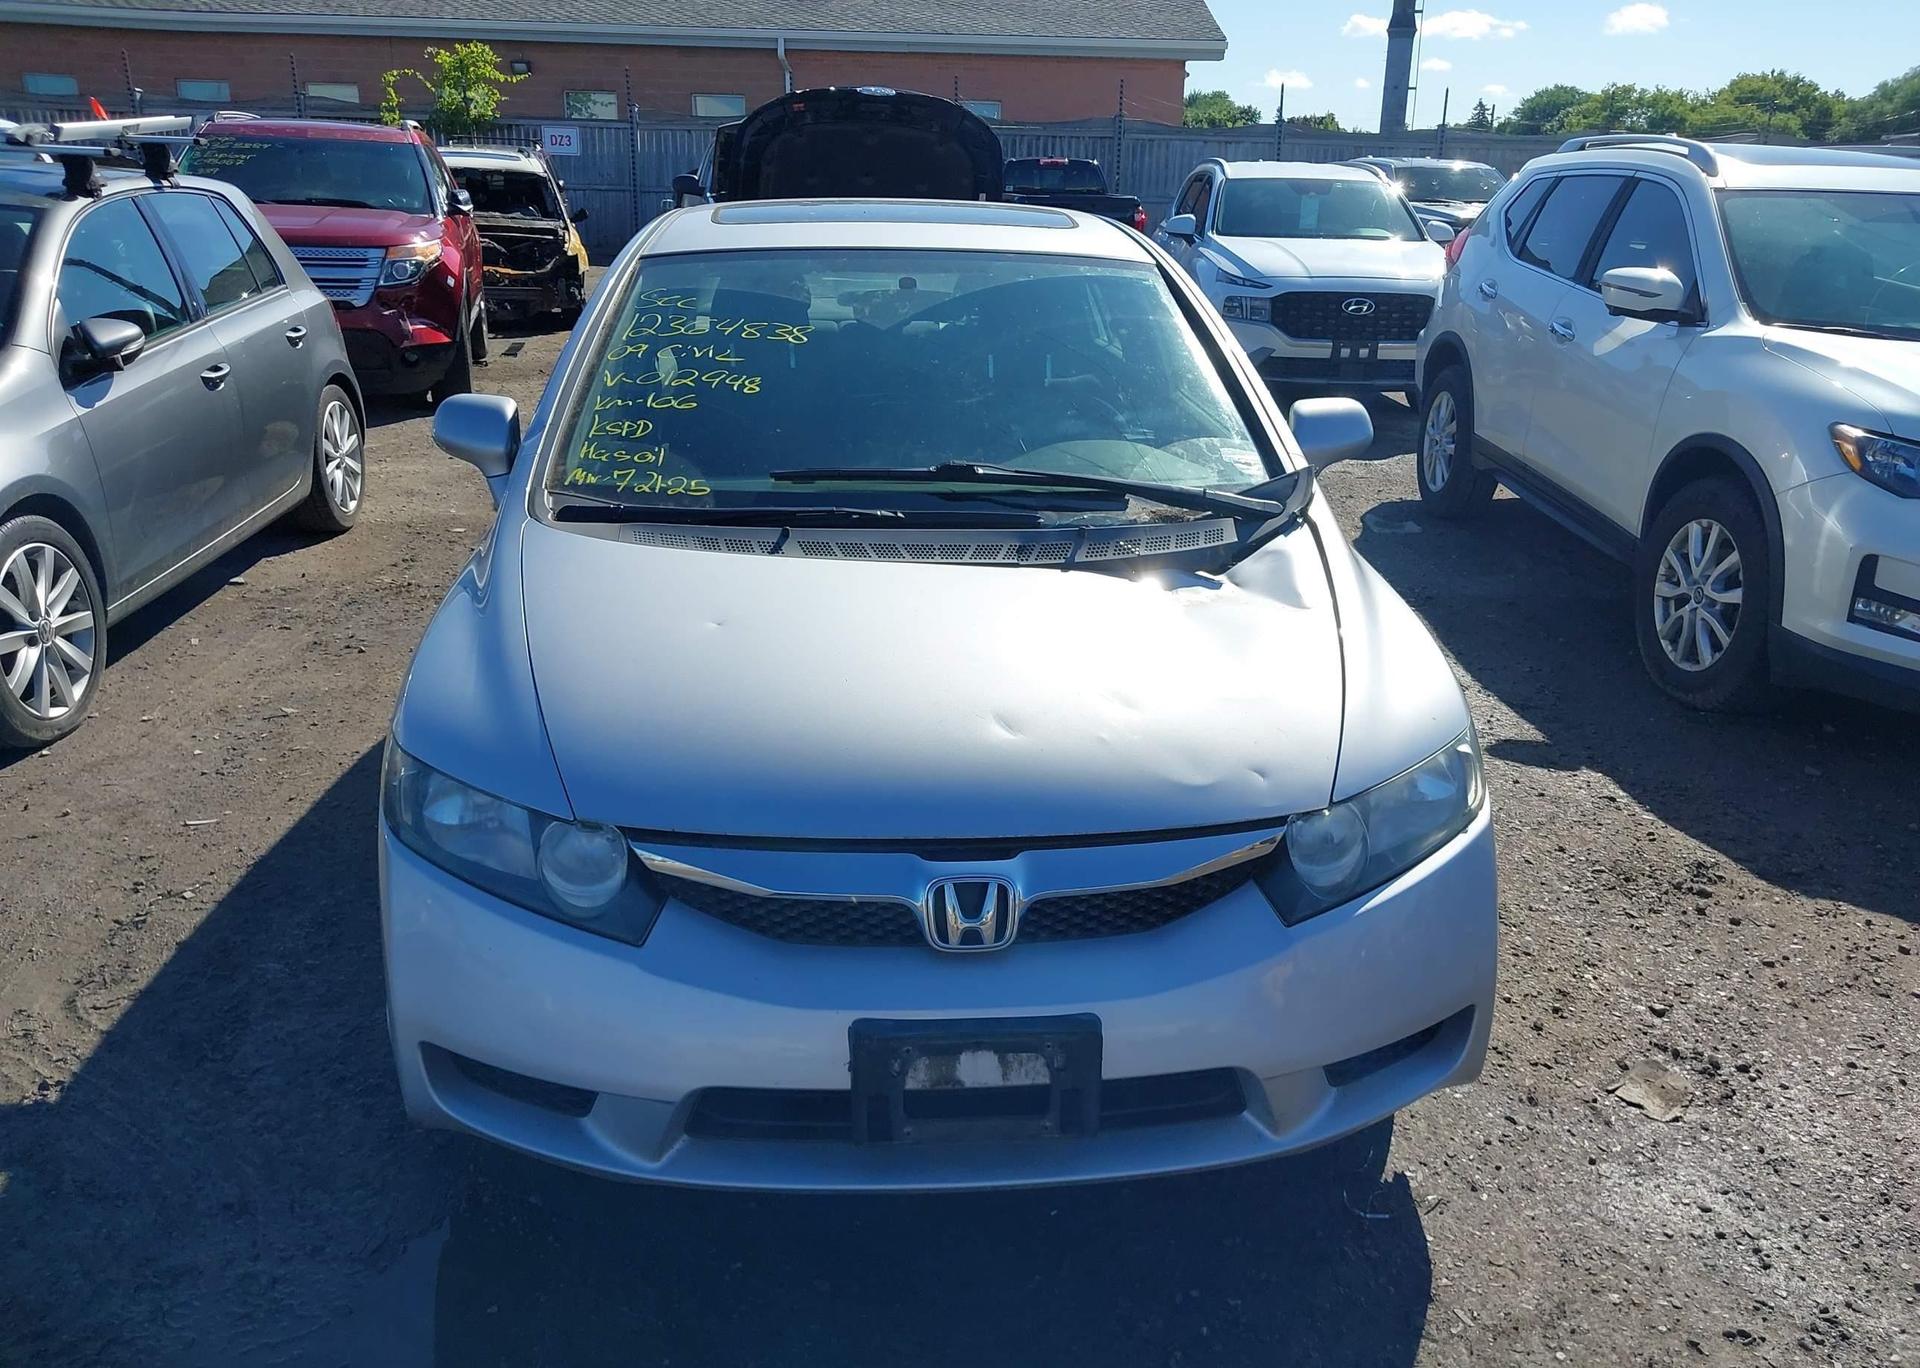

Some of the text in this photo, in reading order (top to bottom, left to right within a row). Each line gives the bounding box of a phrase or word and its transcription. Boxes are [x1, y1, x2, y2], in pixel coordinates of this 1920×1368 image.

[550, 134, 572, 147] DZ3
[607, 343, 649, 361] 09
[588, 414, 653, 438] KSPD
